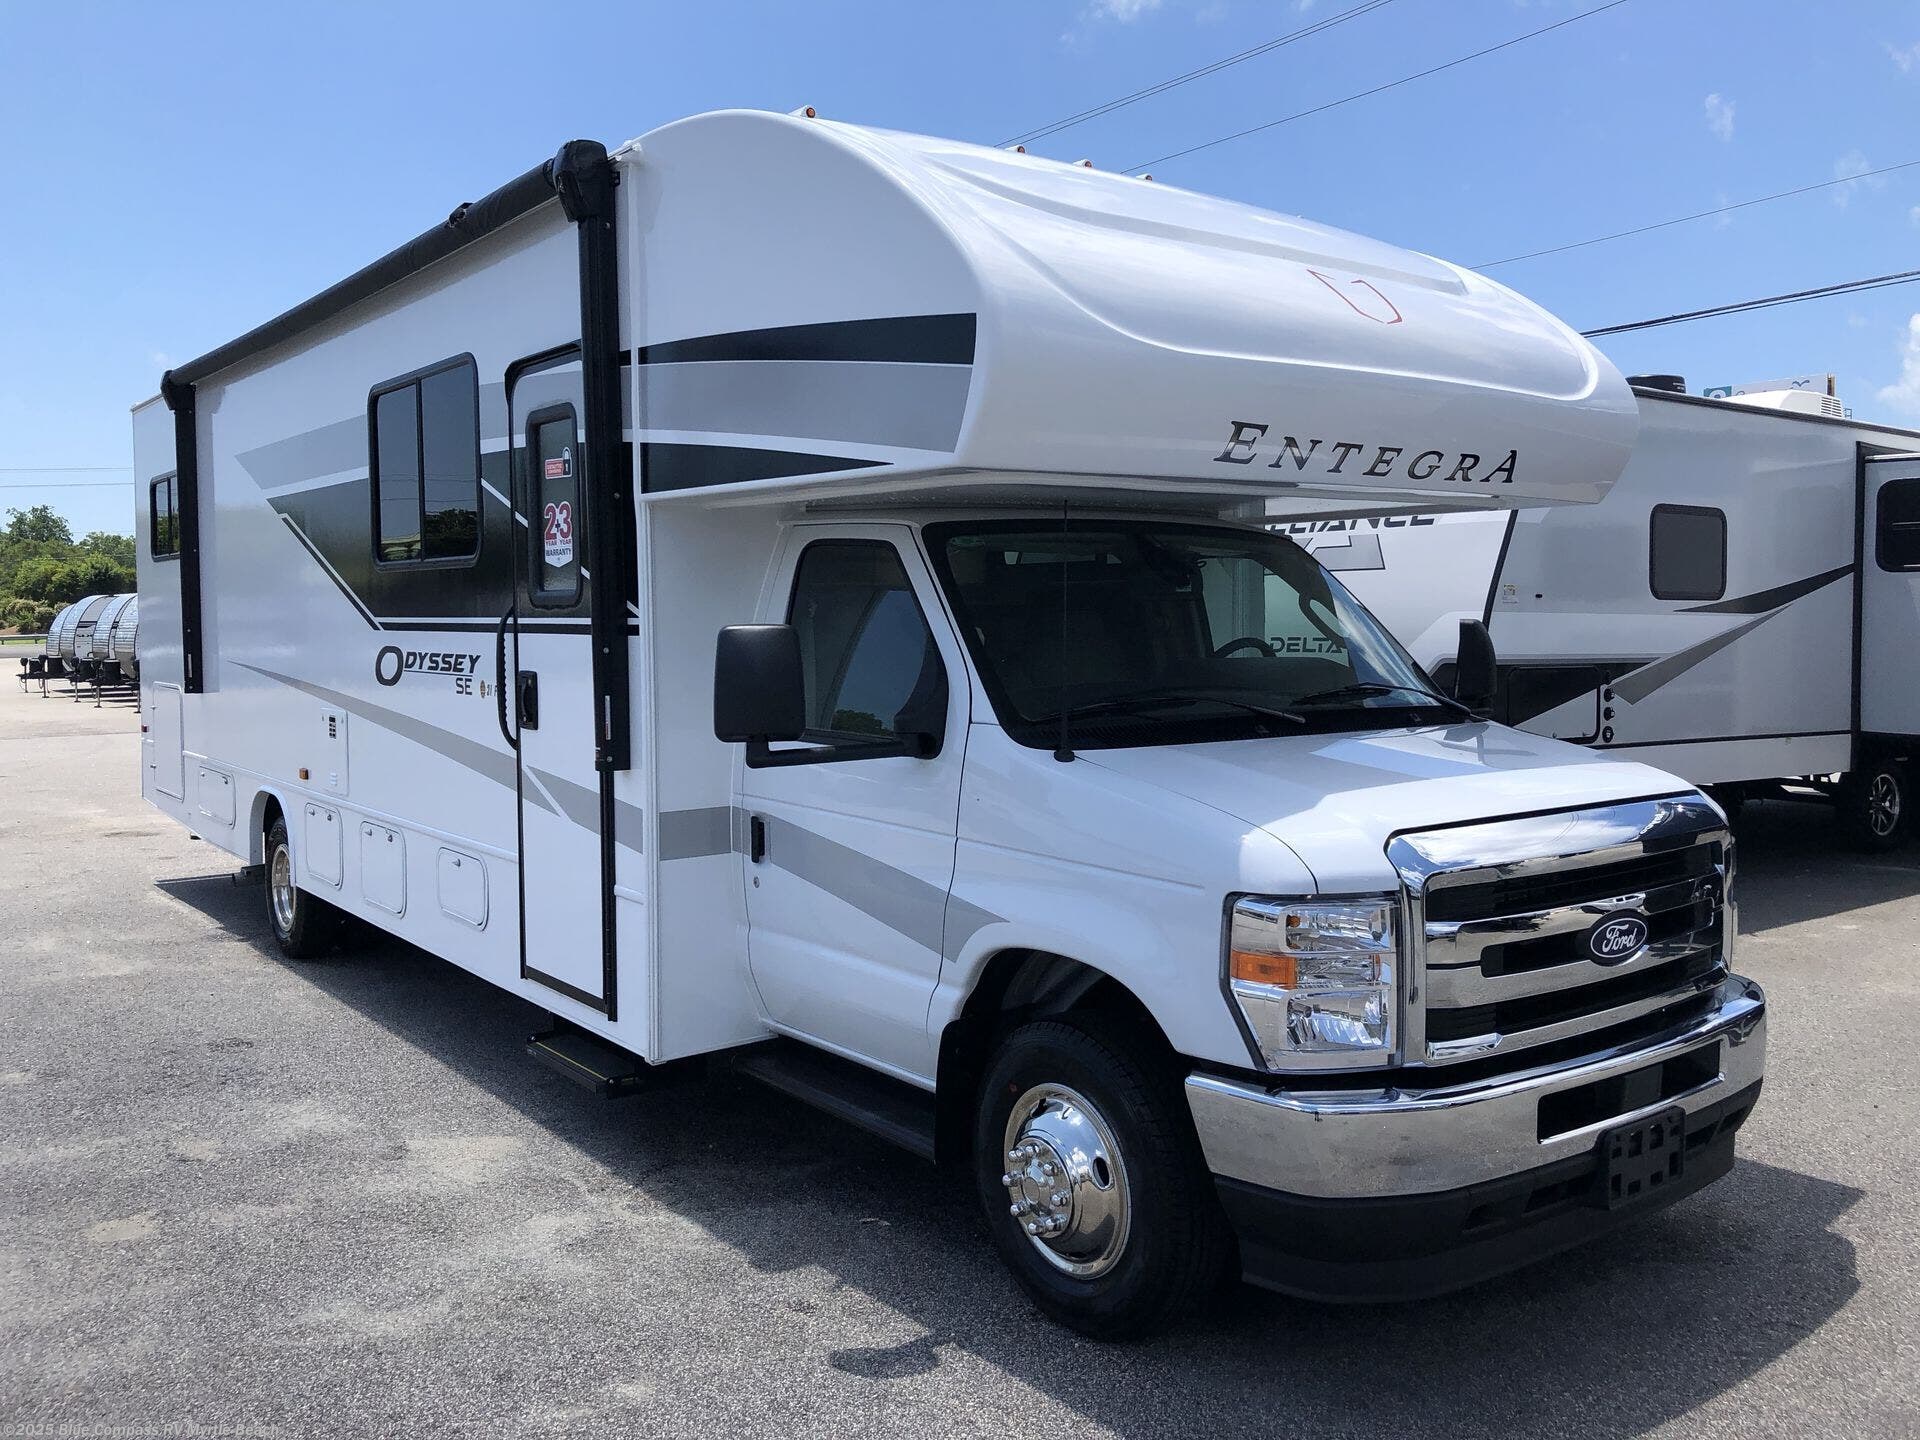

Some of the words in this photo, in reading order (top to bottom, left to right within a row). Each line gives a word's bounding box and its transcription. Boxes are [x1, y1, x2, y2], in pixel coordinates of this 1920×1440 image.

[1213, 420, 1518, 484] ENTEGRA
[1270, 636, 1342, 654] DELTA
[375, 645, 481, 686] ODYSSEY
[455, 677, 473, 696] SE
[1602, 923, 1638, 953] Ford
